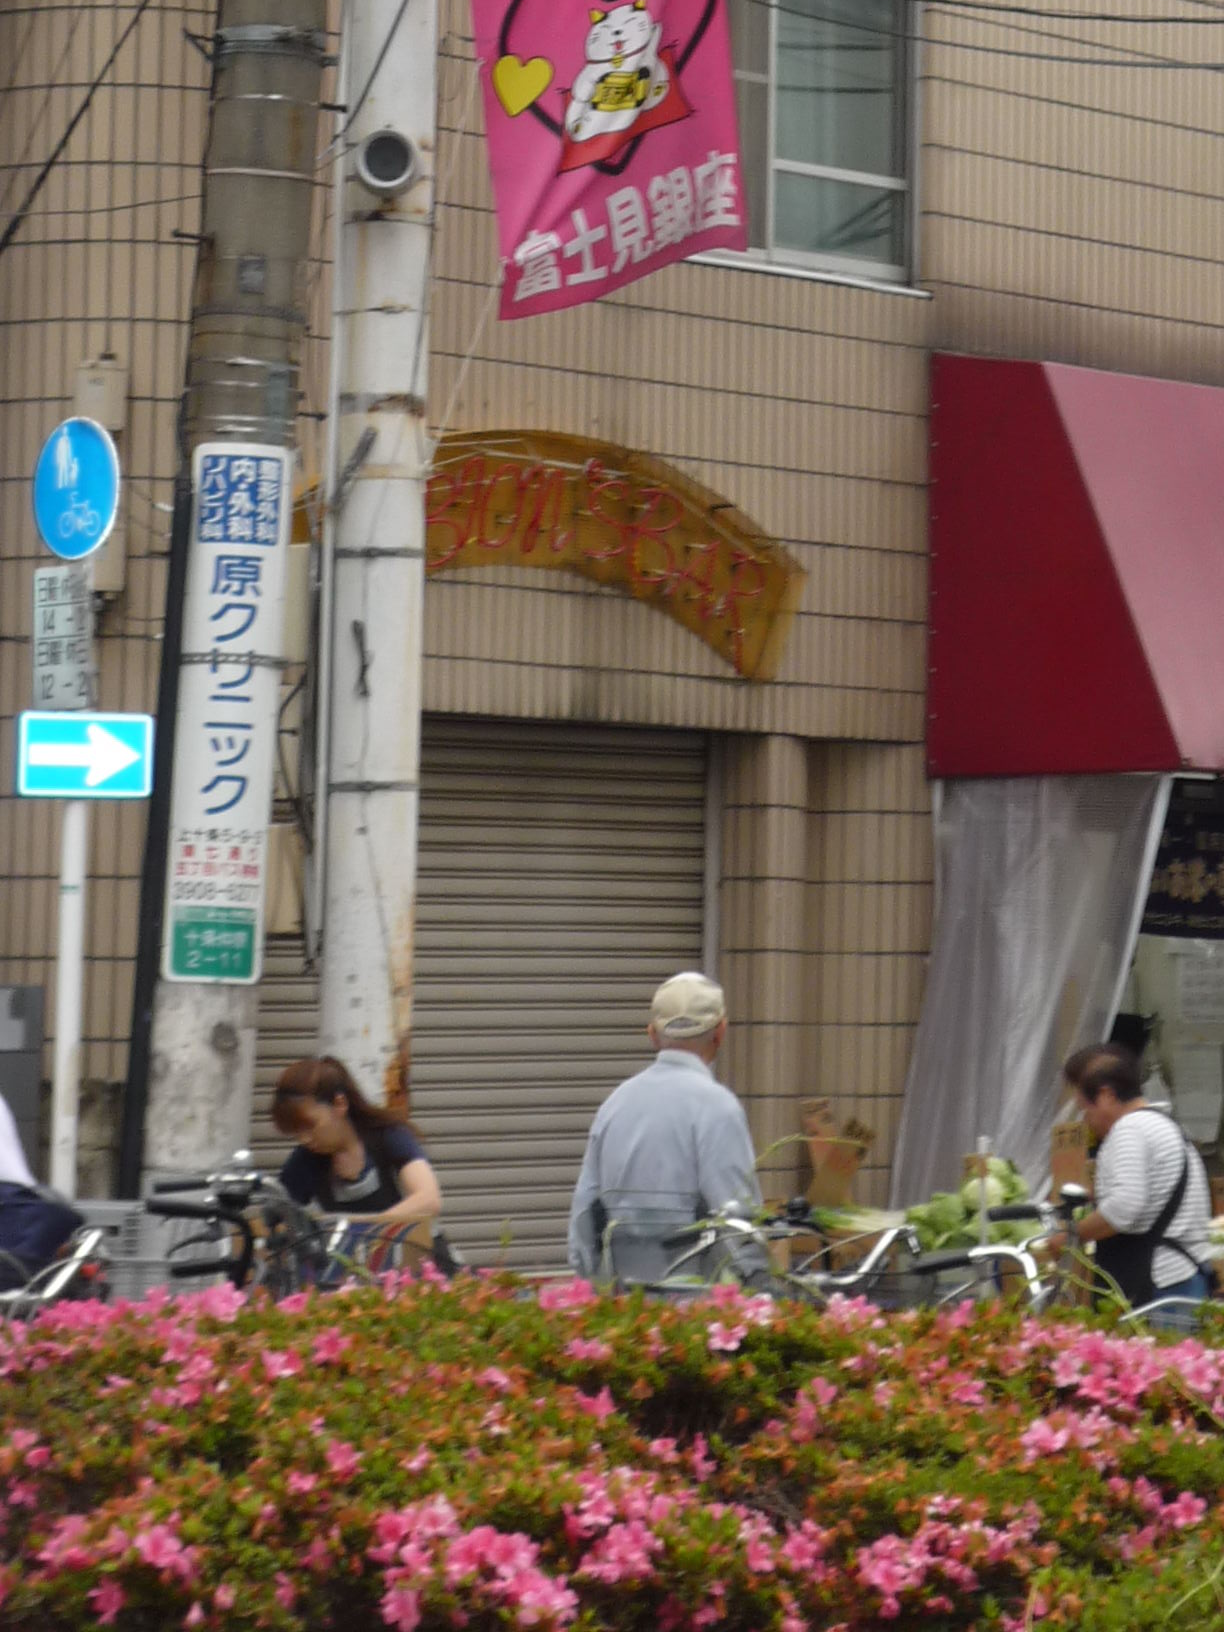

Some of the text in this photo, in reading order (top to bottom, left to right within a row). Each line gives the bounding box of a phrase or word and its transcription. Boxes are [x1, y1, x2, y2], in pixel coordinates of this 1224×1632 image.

[514, 151, 740, 302] 富士見銀座
[201, 554, 264, 816] 原クリニック
[186, 950, 242, 968] 2-11
